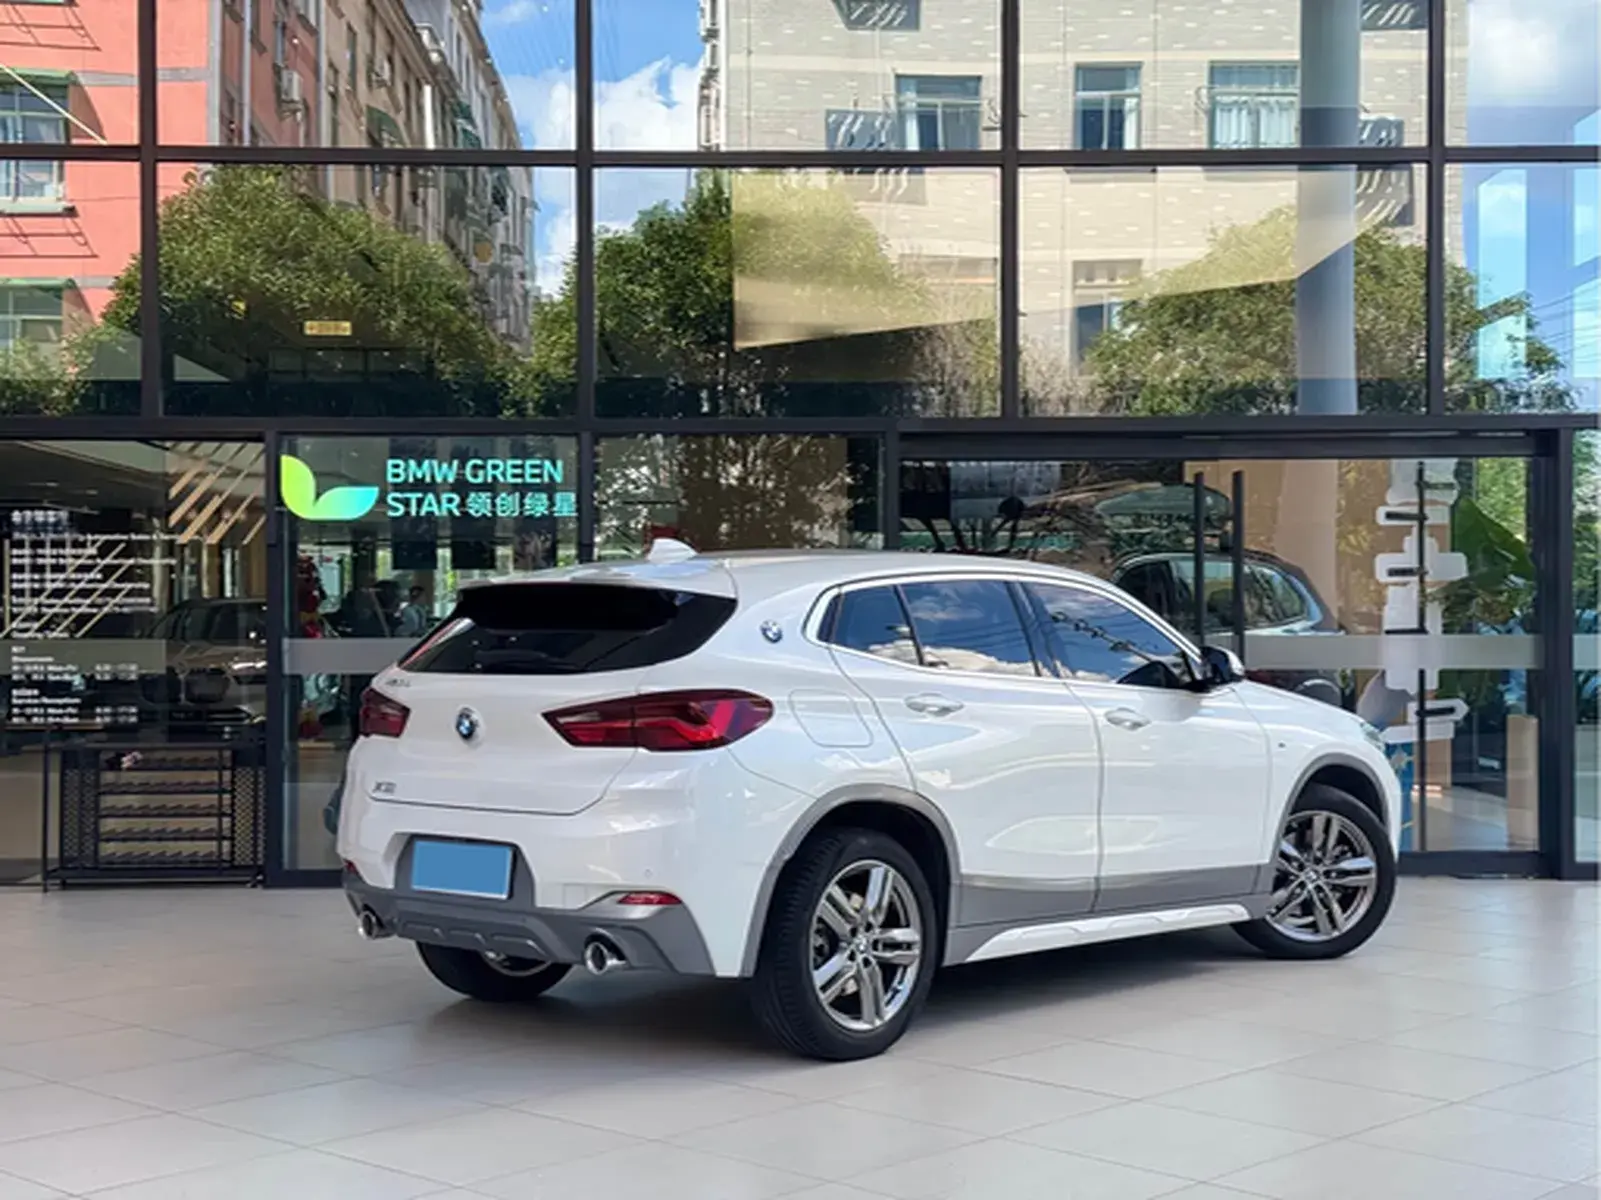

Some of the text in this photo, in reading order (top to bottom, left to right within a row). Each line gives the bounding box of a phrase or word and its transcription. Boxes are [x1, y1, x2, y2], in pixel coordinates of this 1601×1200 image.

[386, 459, 563, 483] BMW GREEN
[386, 492, 578, 517] STAR 领创绿星
